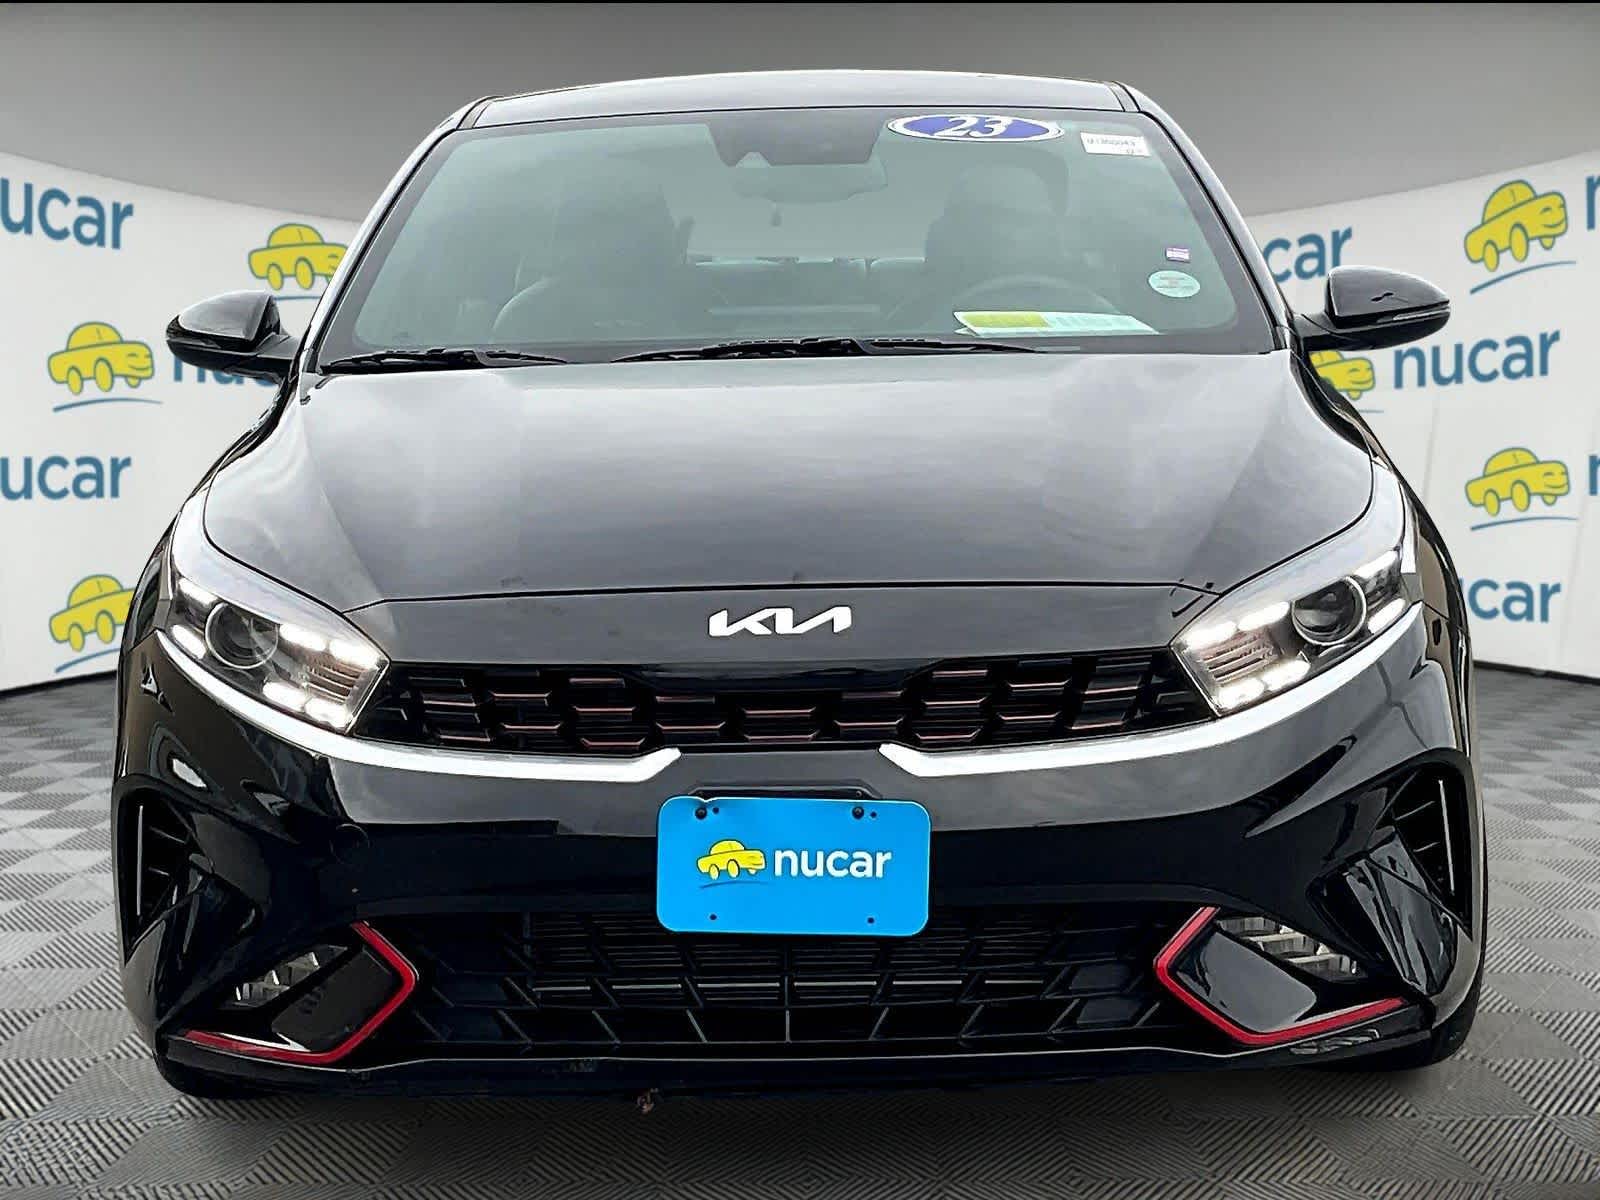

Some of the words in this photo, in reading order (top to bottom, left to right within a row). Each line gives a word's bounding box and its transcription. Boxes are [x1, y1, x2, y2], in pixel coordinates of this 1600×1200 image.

[933, 115, 1011, 138] 23
[1394, 330, 1560, 390] nucar
[1460, 577, 1561, 624] car
[774, 849, 892, 878] nucar
